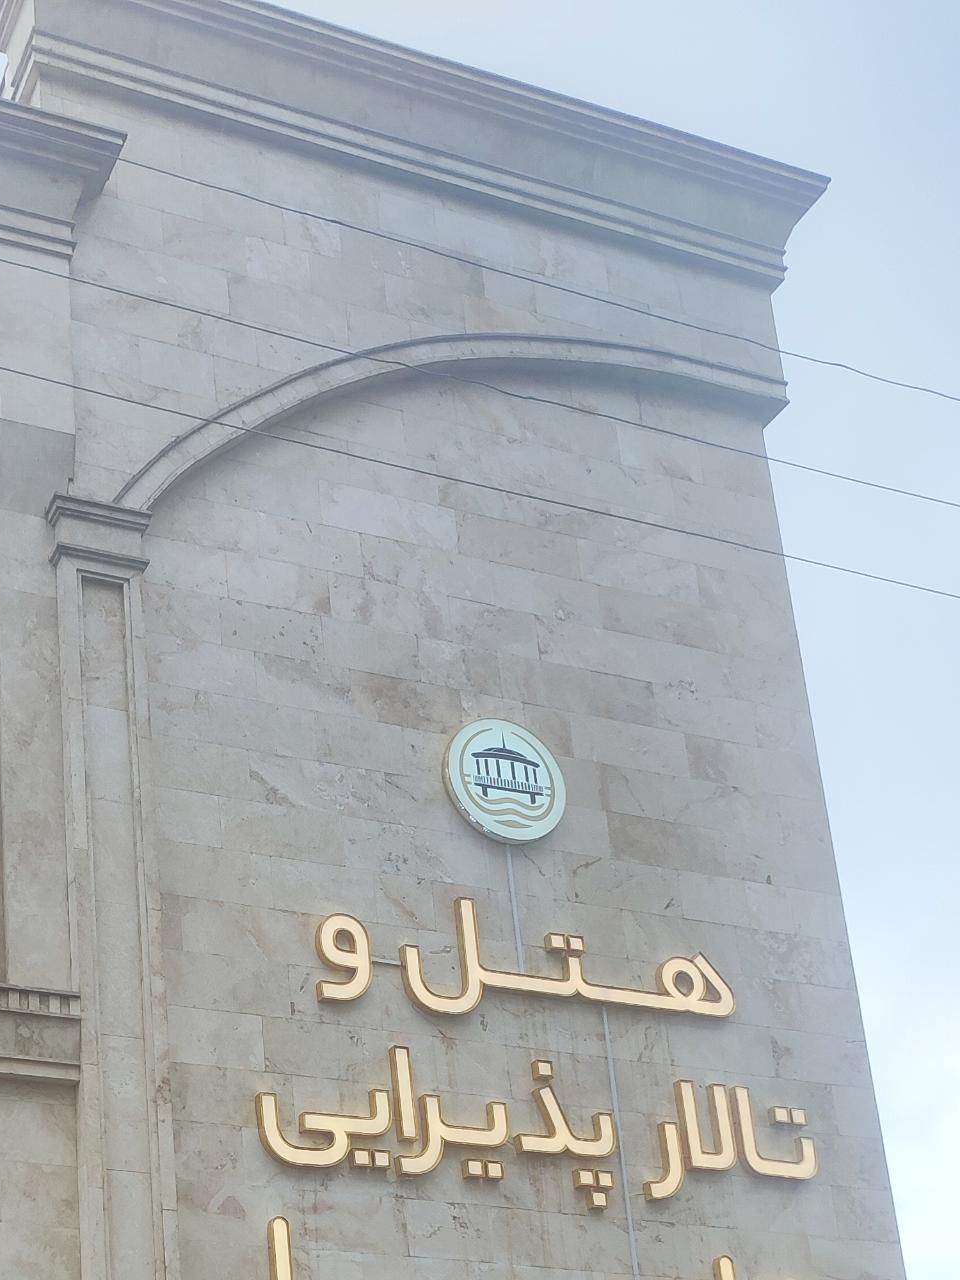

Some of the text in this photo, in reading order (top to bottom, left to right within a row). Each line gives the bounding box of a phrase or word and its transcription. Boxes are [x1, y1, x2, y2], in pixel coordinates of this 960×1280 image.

[315, 896, 736, 1018] هتل و
[255, 1044, 820, 1211] تالار پذیرایی
